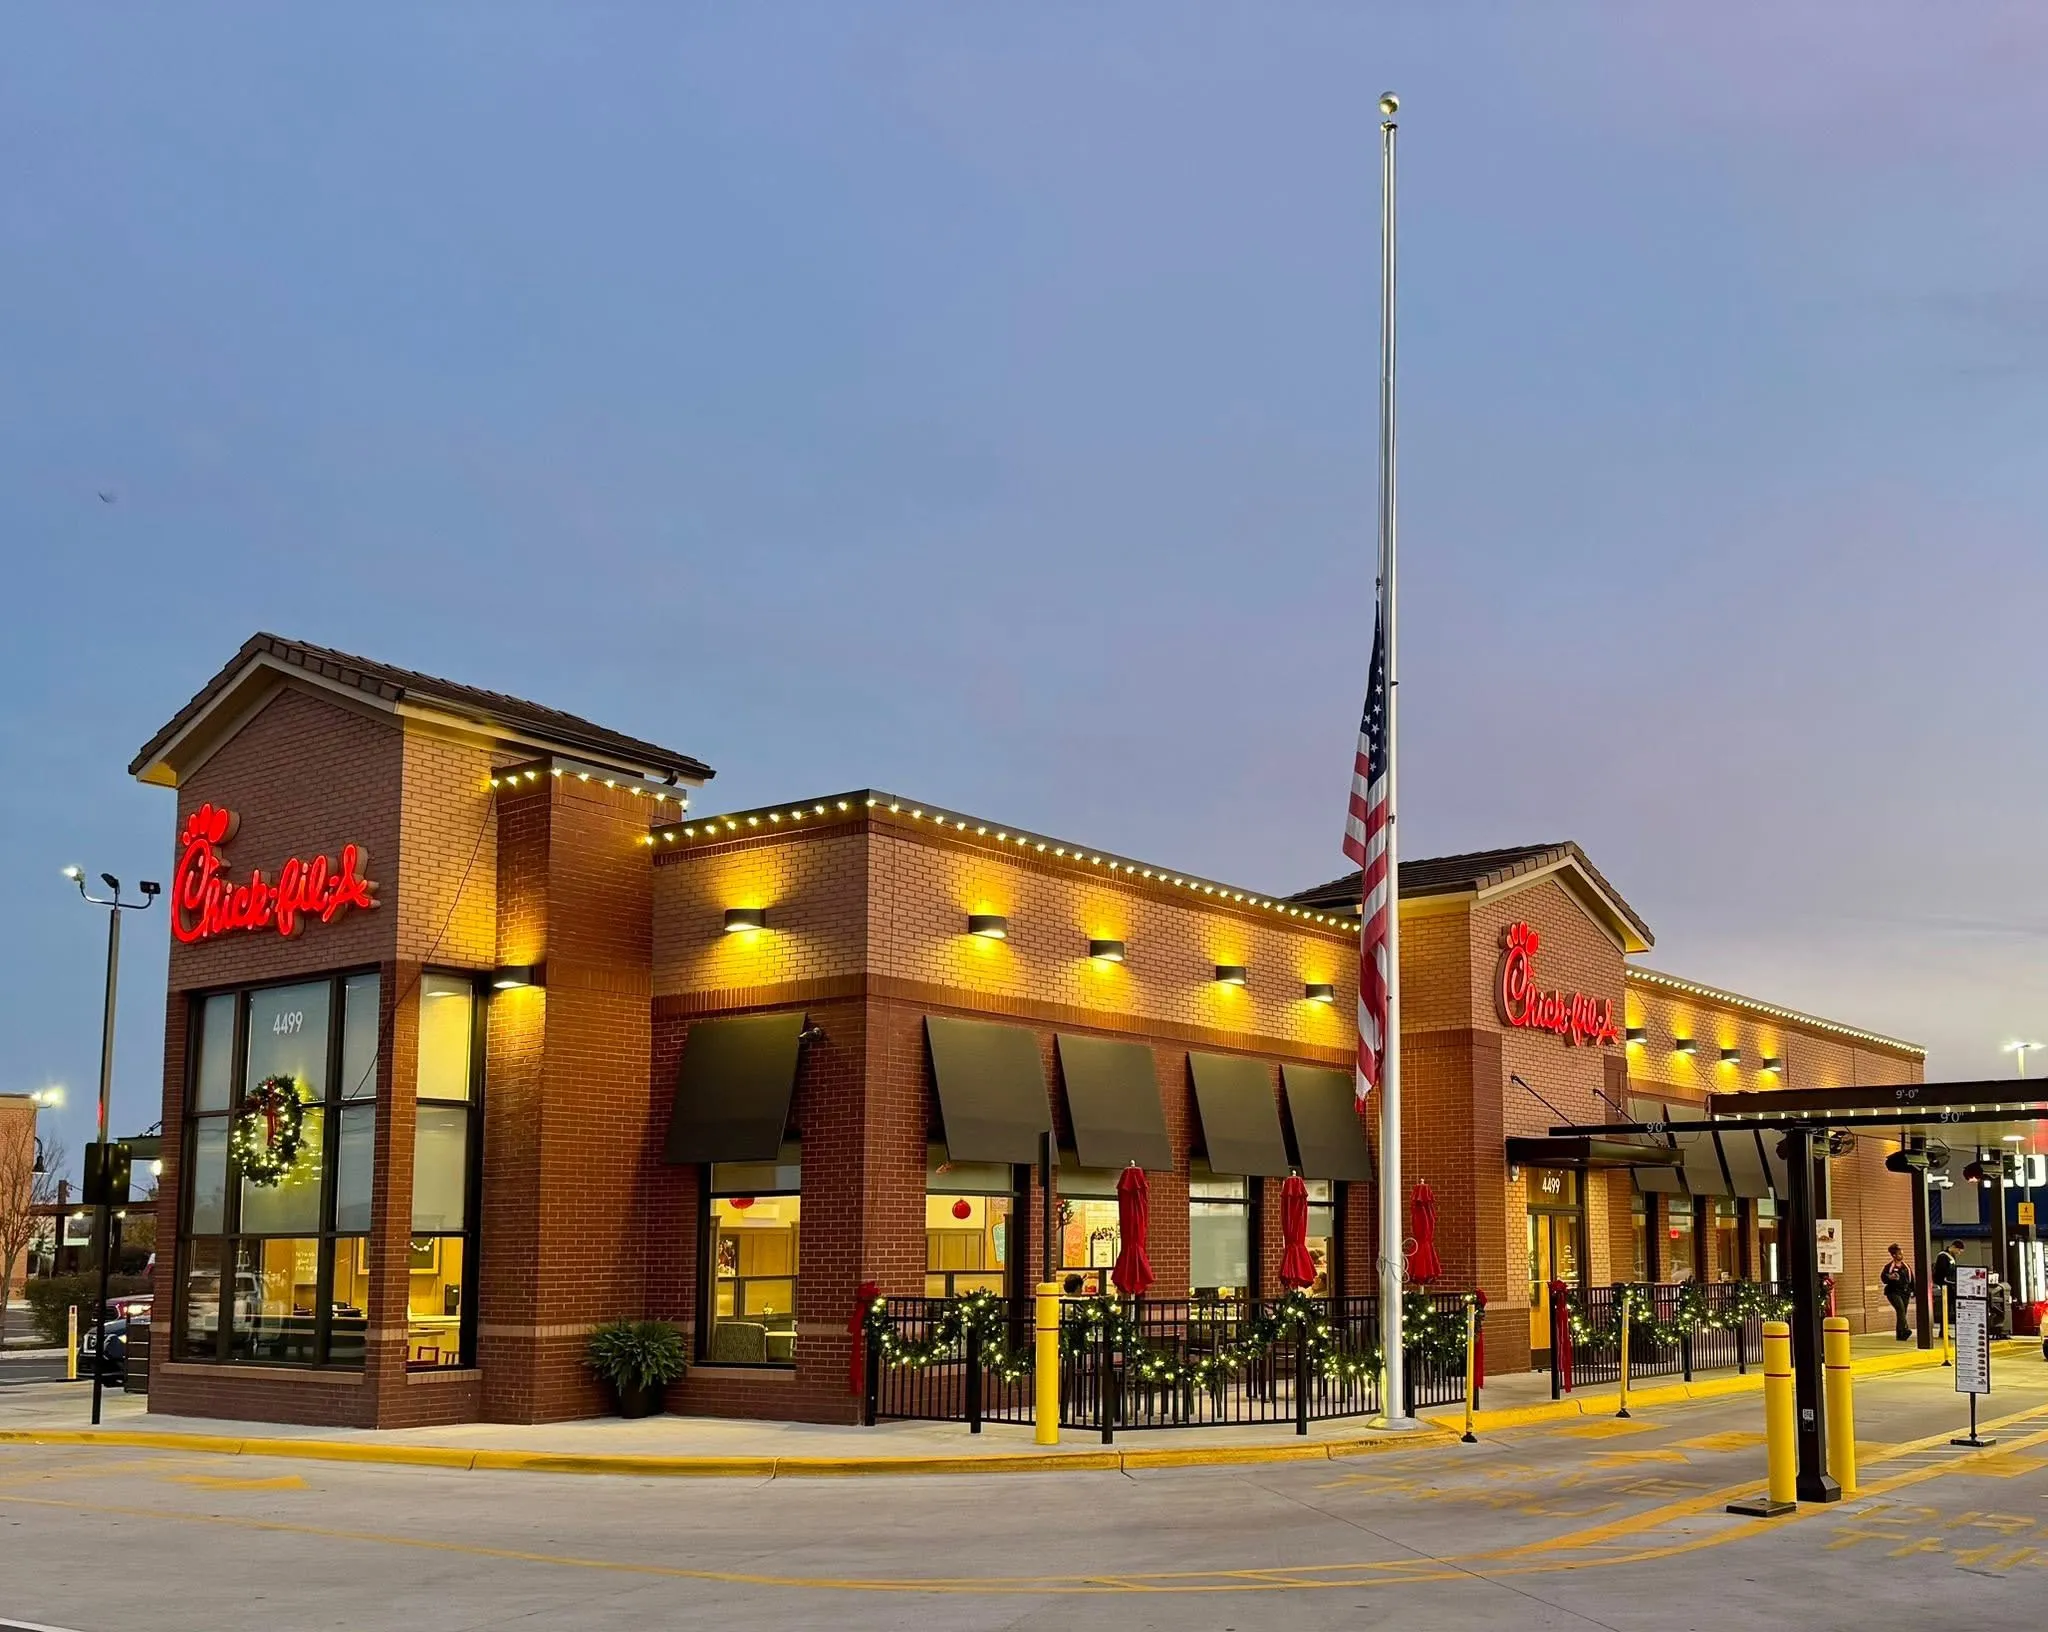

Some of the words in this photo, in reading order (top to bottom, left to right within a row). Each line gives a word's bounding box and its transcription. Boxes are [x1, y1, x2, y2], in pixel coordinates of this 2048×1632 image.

[172, 804, 370, 943] Chick-fil-A
[1503, 921, 1619, 1047] Chick-fil-A
[273, 1011, 303, 1035] 4499
[1541, 1176, 1560, 1194] 4499
